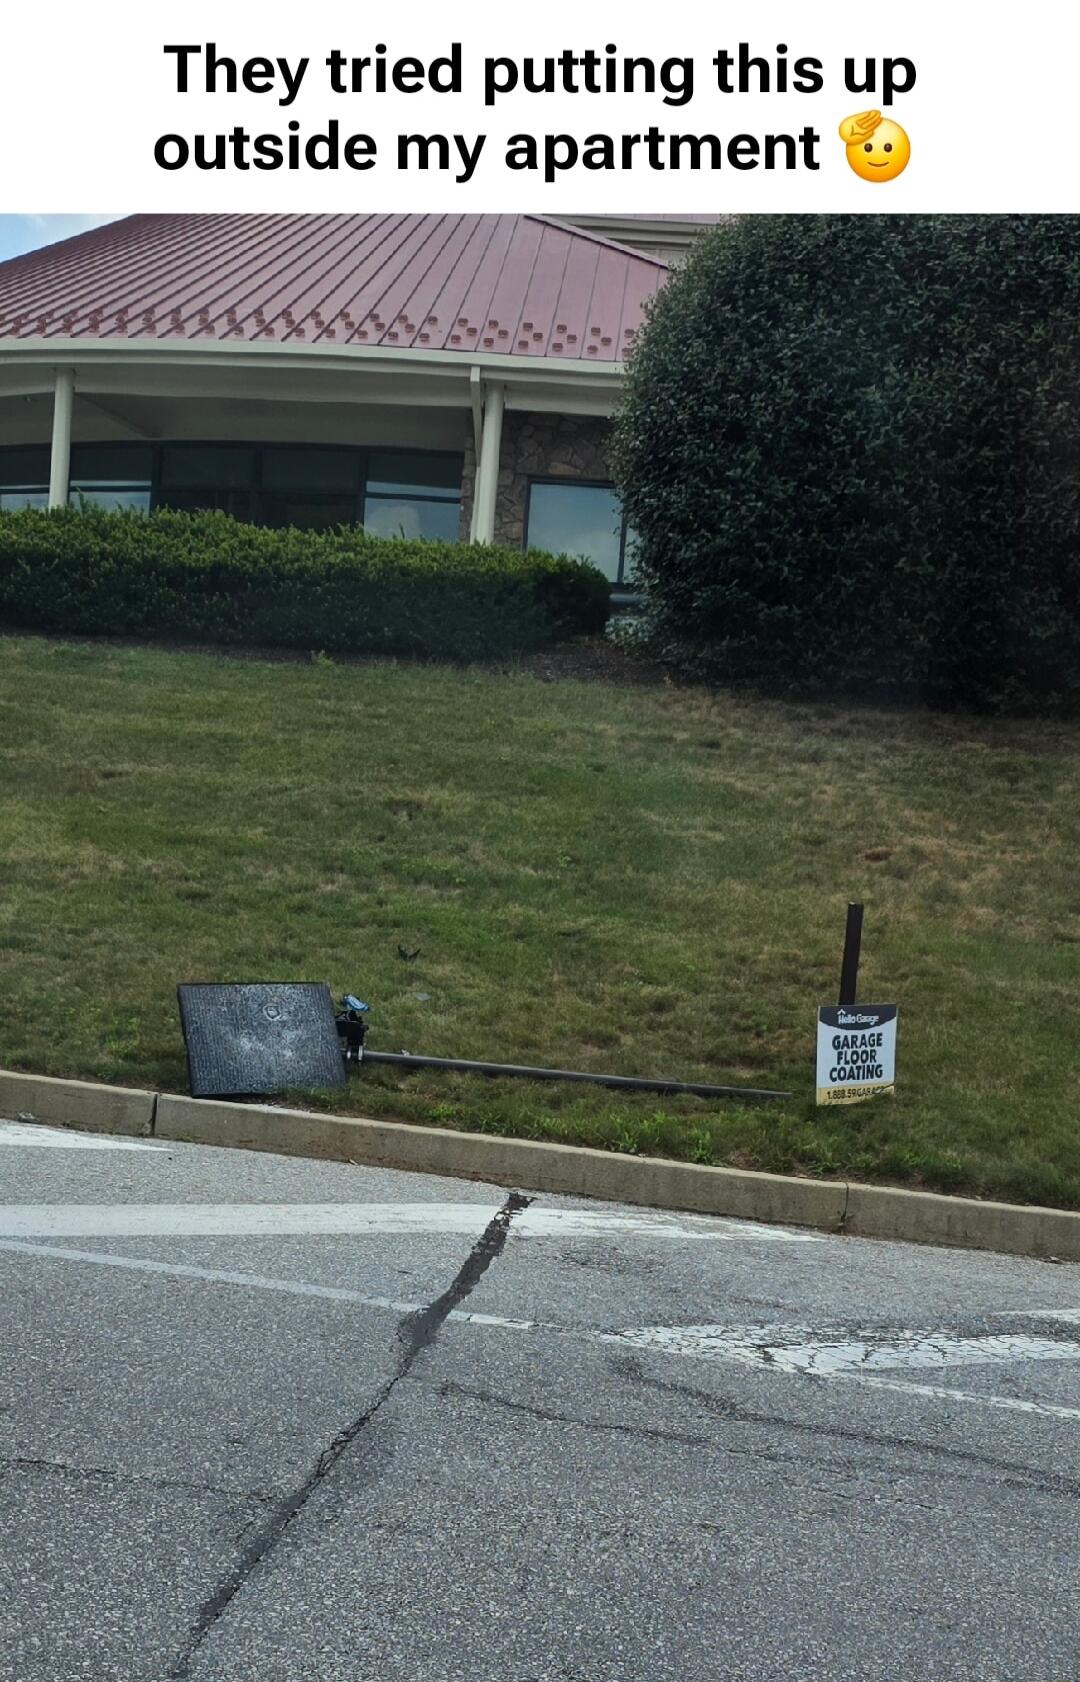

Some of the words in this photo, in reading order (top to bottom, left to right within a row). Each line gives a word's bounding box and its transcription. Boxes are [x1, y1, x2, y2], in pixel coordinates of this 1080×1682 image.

[838, 1014, 856, 1024] Hello
[856, 1014, 879, 1025] Garage
[832, 1033, 883, 1050] GARAGE
[837, 1049, 877, 1065] FLOOR
[829, 1064, 883, 1082] COATING
